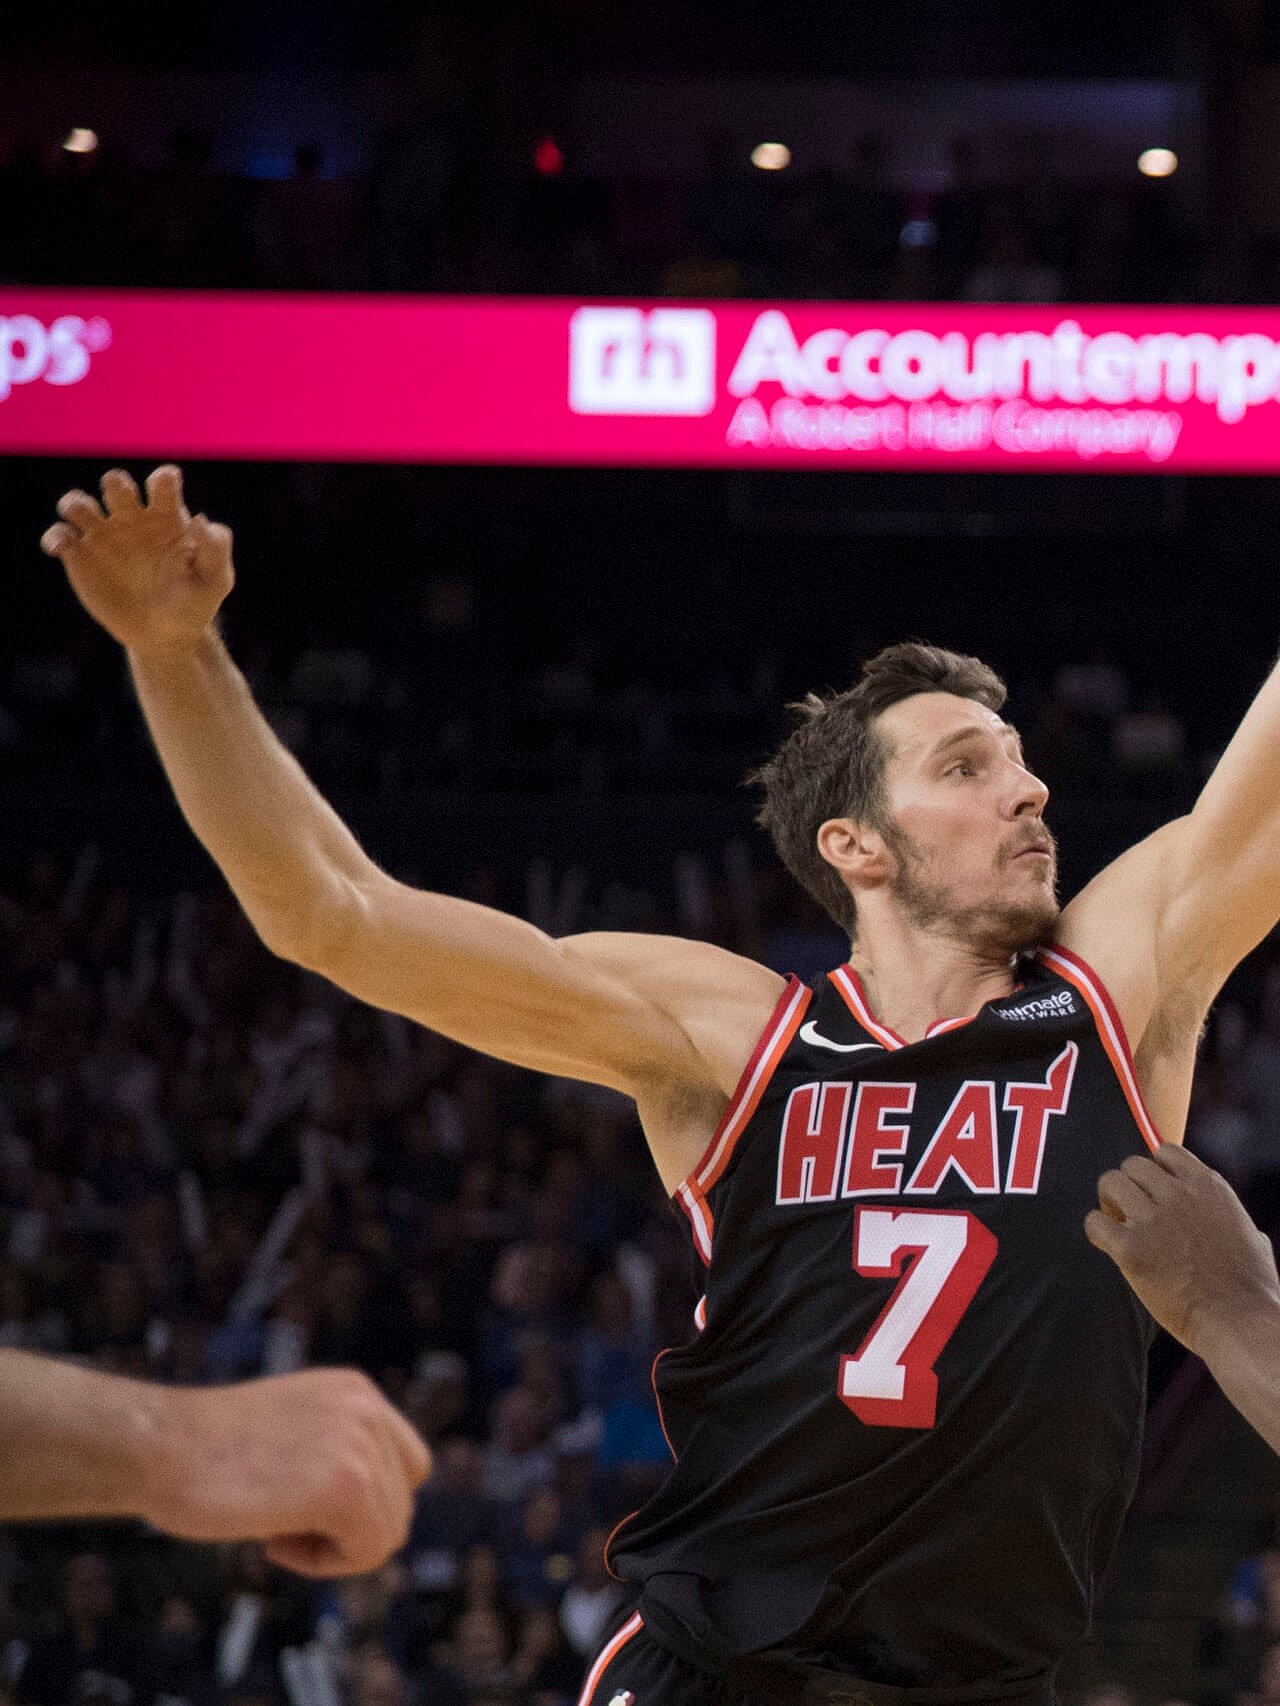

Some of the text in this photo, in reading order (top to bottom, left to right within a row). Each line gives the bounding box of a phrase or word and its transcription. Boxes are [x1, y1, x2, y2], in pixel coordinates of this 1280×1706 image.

[727, 397, 771, 449] A
[1001, 1004, 1076, 1021] TWARE
[775, 1040, 1079, 1205] HEAT
[837, 1204, 999, 1429] 7
